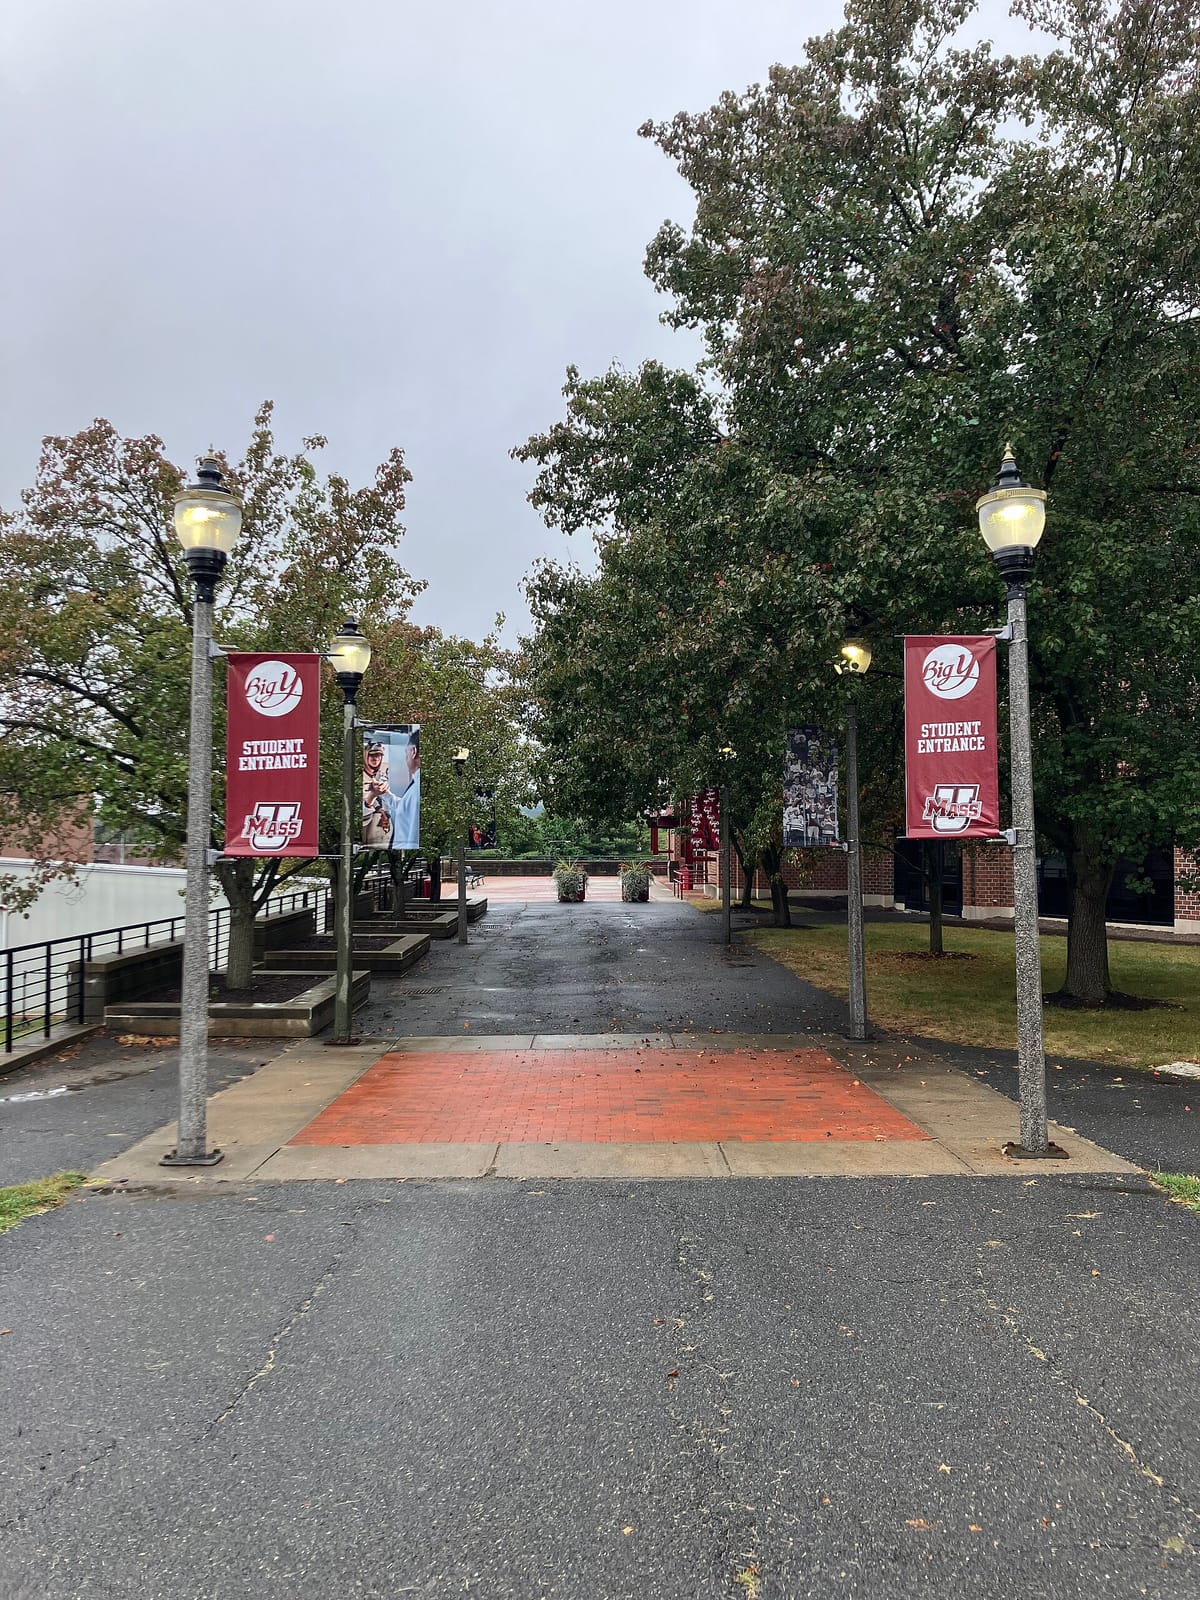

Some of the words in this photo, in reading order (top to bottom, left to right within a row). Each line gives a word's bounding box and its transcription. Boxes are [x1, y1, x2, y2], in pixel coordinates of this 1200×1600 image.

[922, 660, 954, 686] Big
[245, 676, 276, 703] Big
[920, 720, 982, 738] STUDENT
[242, 738, 304, 755] STUDENT
[917, 736, 986, 754] ENTRANCE
[238, 754, 308, 771] ENTRANCE
